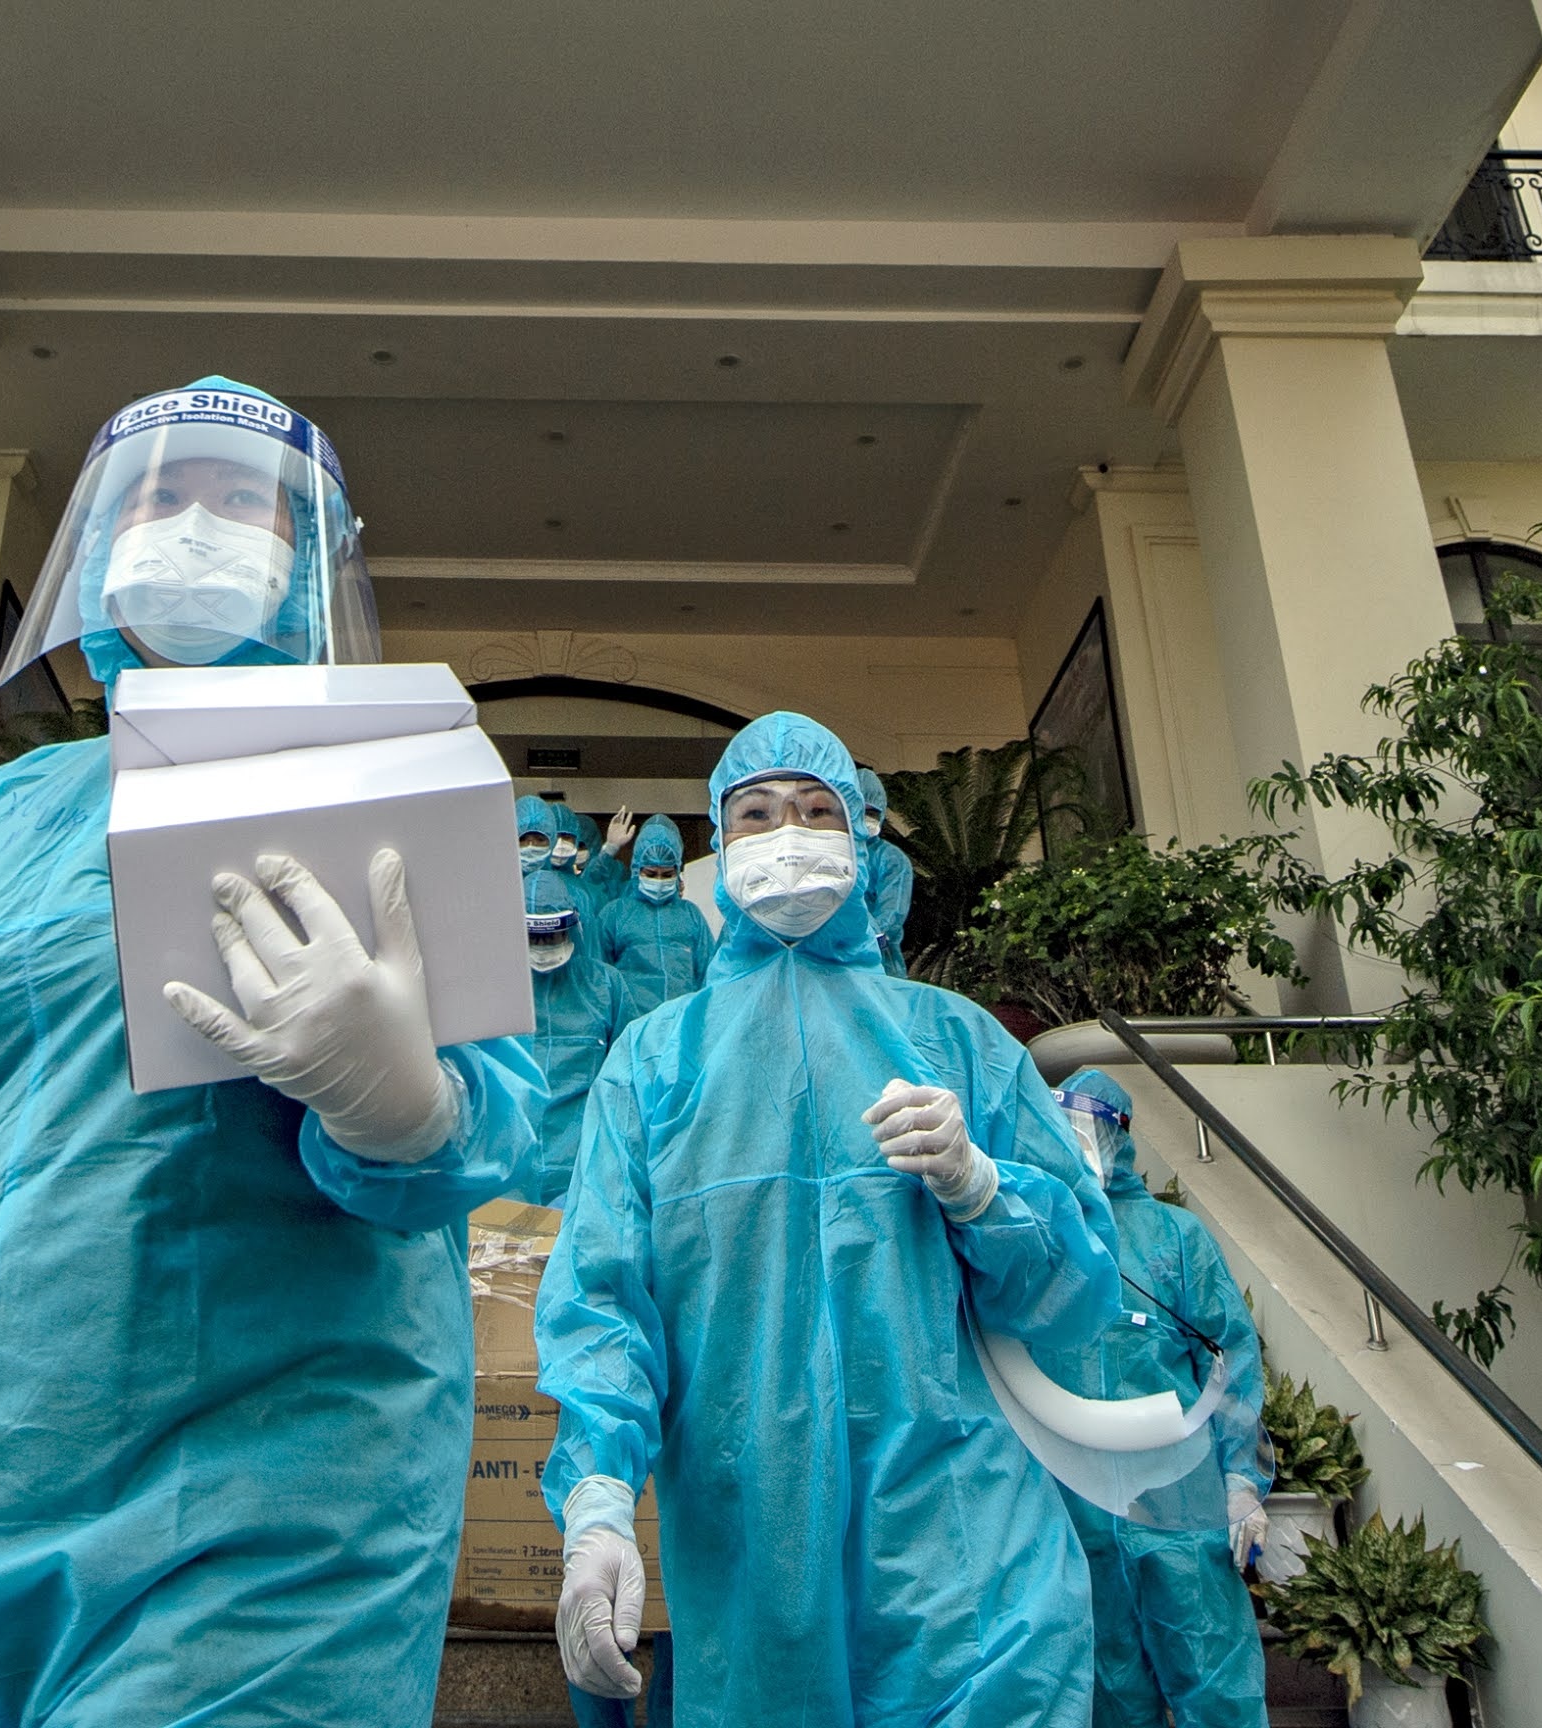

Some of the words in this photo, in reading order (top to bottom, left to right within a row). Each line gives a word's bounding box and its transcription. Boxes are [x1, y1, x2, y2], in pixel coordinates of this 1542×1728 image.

[115, 399, 179, 430] Face
[190, 393, 289, 426] Shield
[182, 411, 234, 423] Isolation
[238, 417, 270, 433] Mask
[472, 1460, 518, 1479] ANTI
